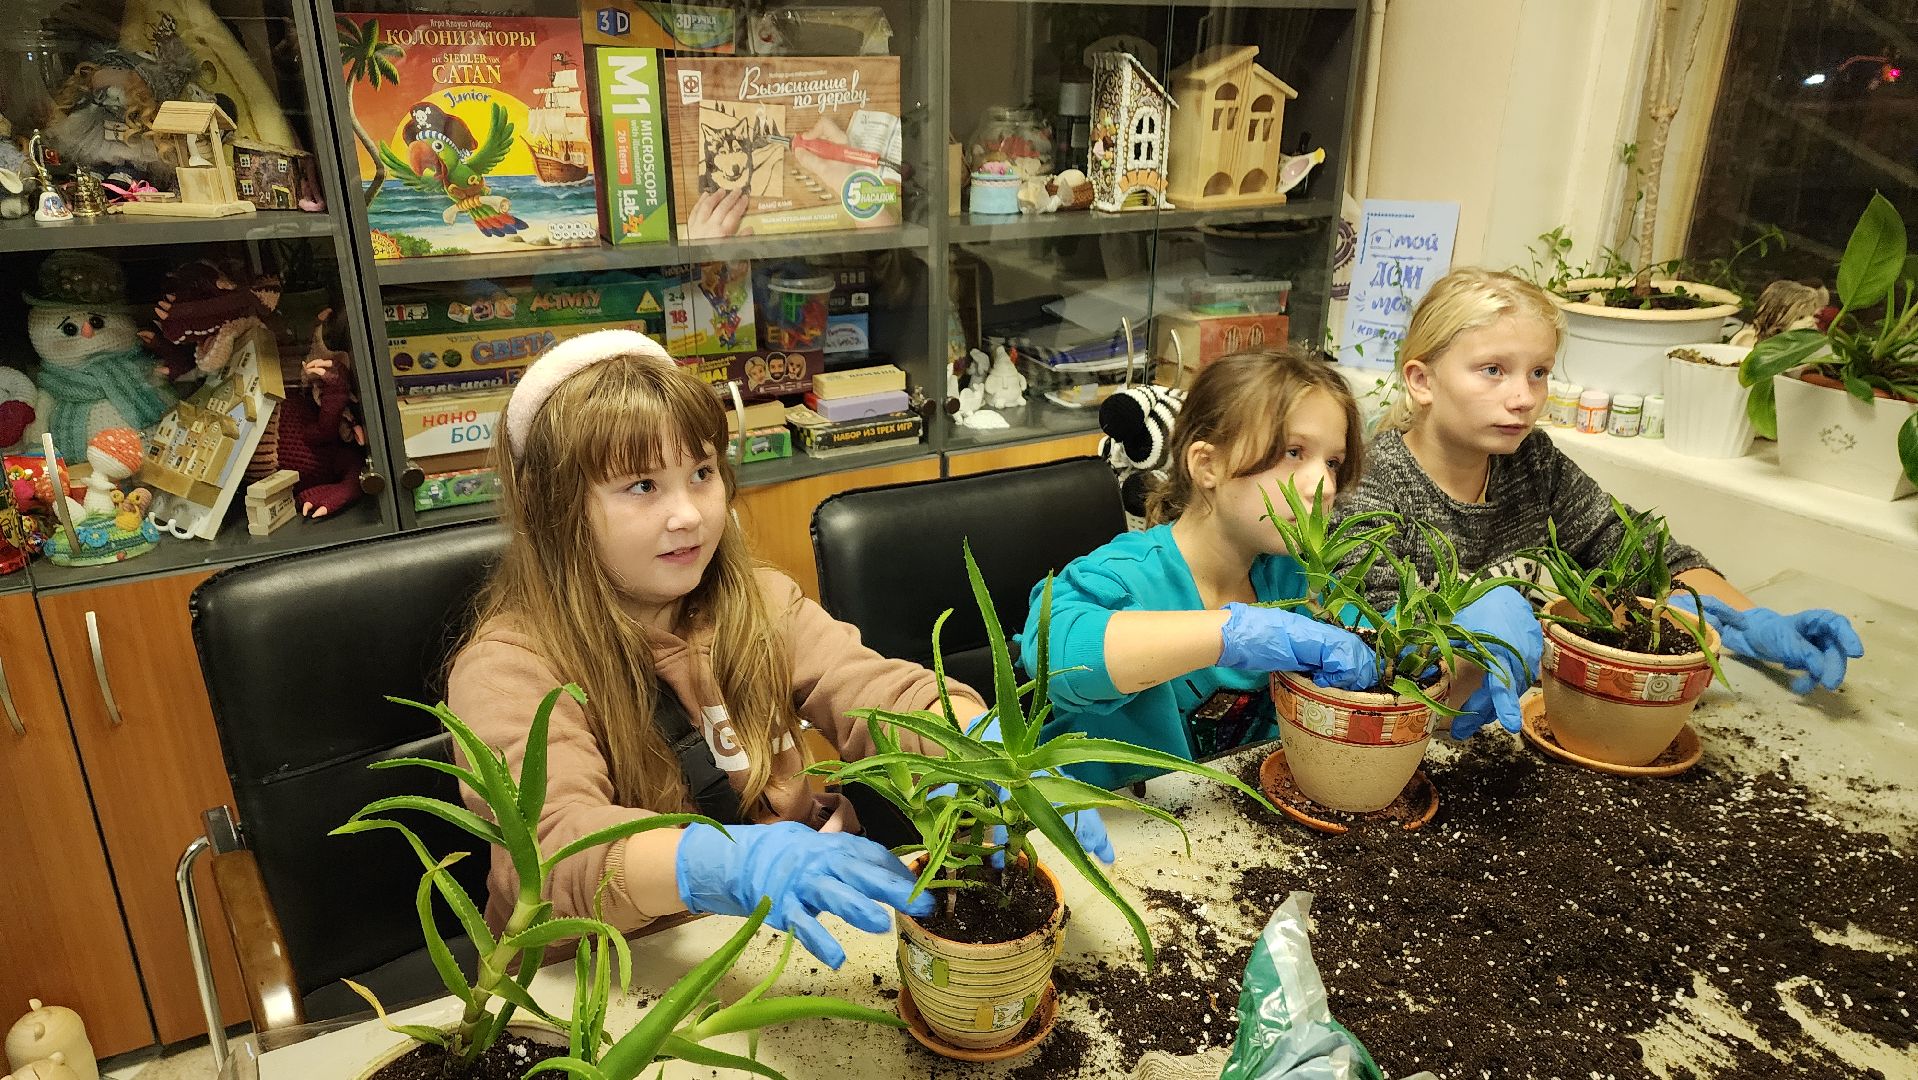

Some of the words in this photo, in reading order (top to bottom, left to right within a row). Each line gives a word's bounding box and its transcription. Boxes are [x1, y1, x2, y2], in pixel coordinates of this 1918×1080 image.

[599, 11, 629, 33] 3D
[385, 29, 537, 47] КОЛОНИЗАТОРЫ
[443, 53, 488, 64] SIEDLER
[432, 64, 502, 84] CATAN
[607, 55, 651, 114] M1
[739, 66, 848, 101] Выжигание
[443, 88, 492, 107] Junior
[793, 92, 812, 107] по
[817, 69, 868, 114] дереву
[617, 130, 626, 142] 20
[630, 119, 638, 138] with
[618, 144, 628, 175] items
[632, 138, 642, 185] illumination
[640, 119, 658, 206] MICROSCOPE
[259, 191, 271, 203] 24
[847, 182, 862, 206] 5
[669, 309, 688, 324] 18
[471, 330, 557, 365] СВЕТА
[833, 431, 862, 442] НАБОР
[863, 428, 876, 437] ИЗ
[897, 422, 913, 432] ИГР
